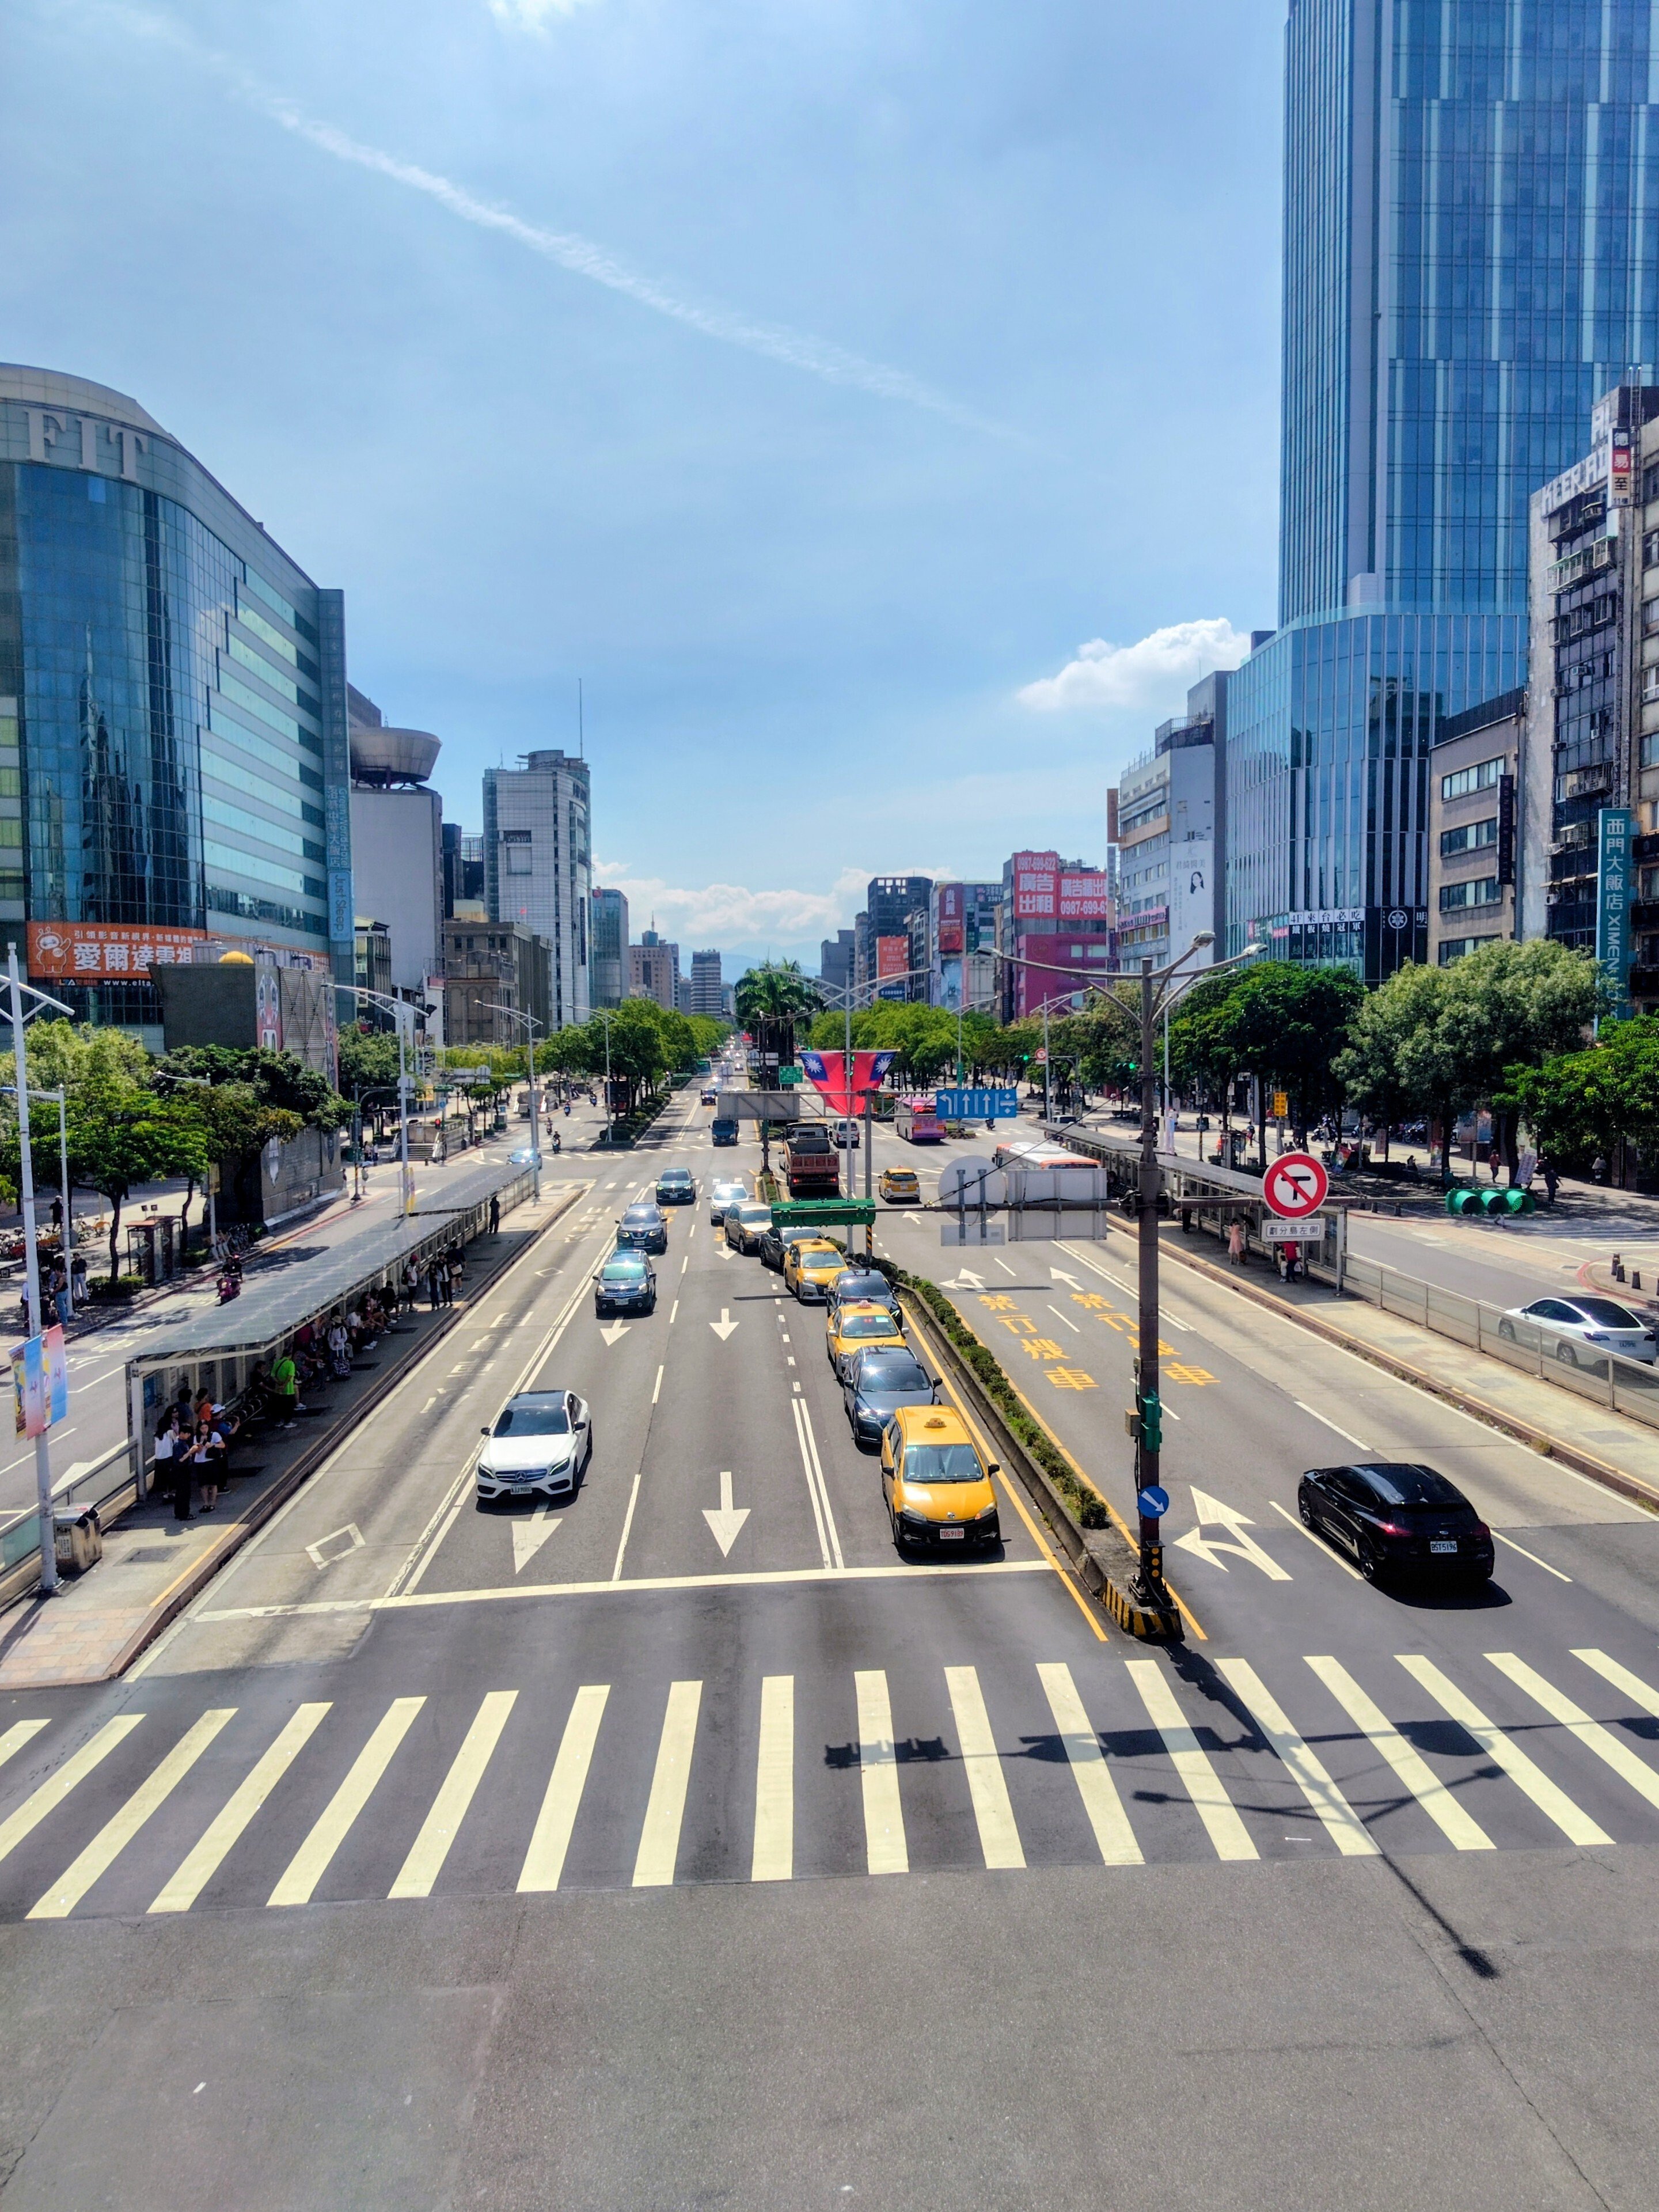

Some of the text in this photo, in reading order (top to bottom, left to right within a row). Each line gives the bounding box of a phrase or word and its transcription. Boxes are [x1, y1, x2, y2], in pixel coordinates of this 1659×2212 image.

[24, 409, 148, 483] FIT
[1614, 432, 1628, 490] 德易至
[1018, 857, 1056, 871] 0987-699-622
[1019, 873, 1054, 891] 廣告
[1605, 818, 1625, 910] 西門大飯店
[335, 875, 347, 932] Just Sleep
[1019, 894, 1054, 913] 出租
[1292, 921, 1361, 935] 鐵板燒冠軍
[1269, 1225, 1318, 1235] 劃分島左側
[977, 1295, 1100, 1391] 禁行機車
